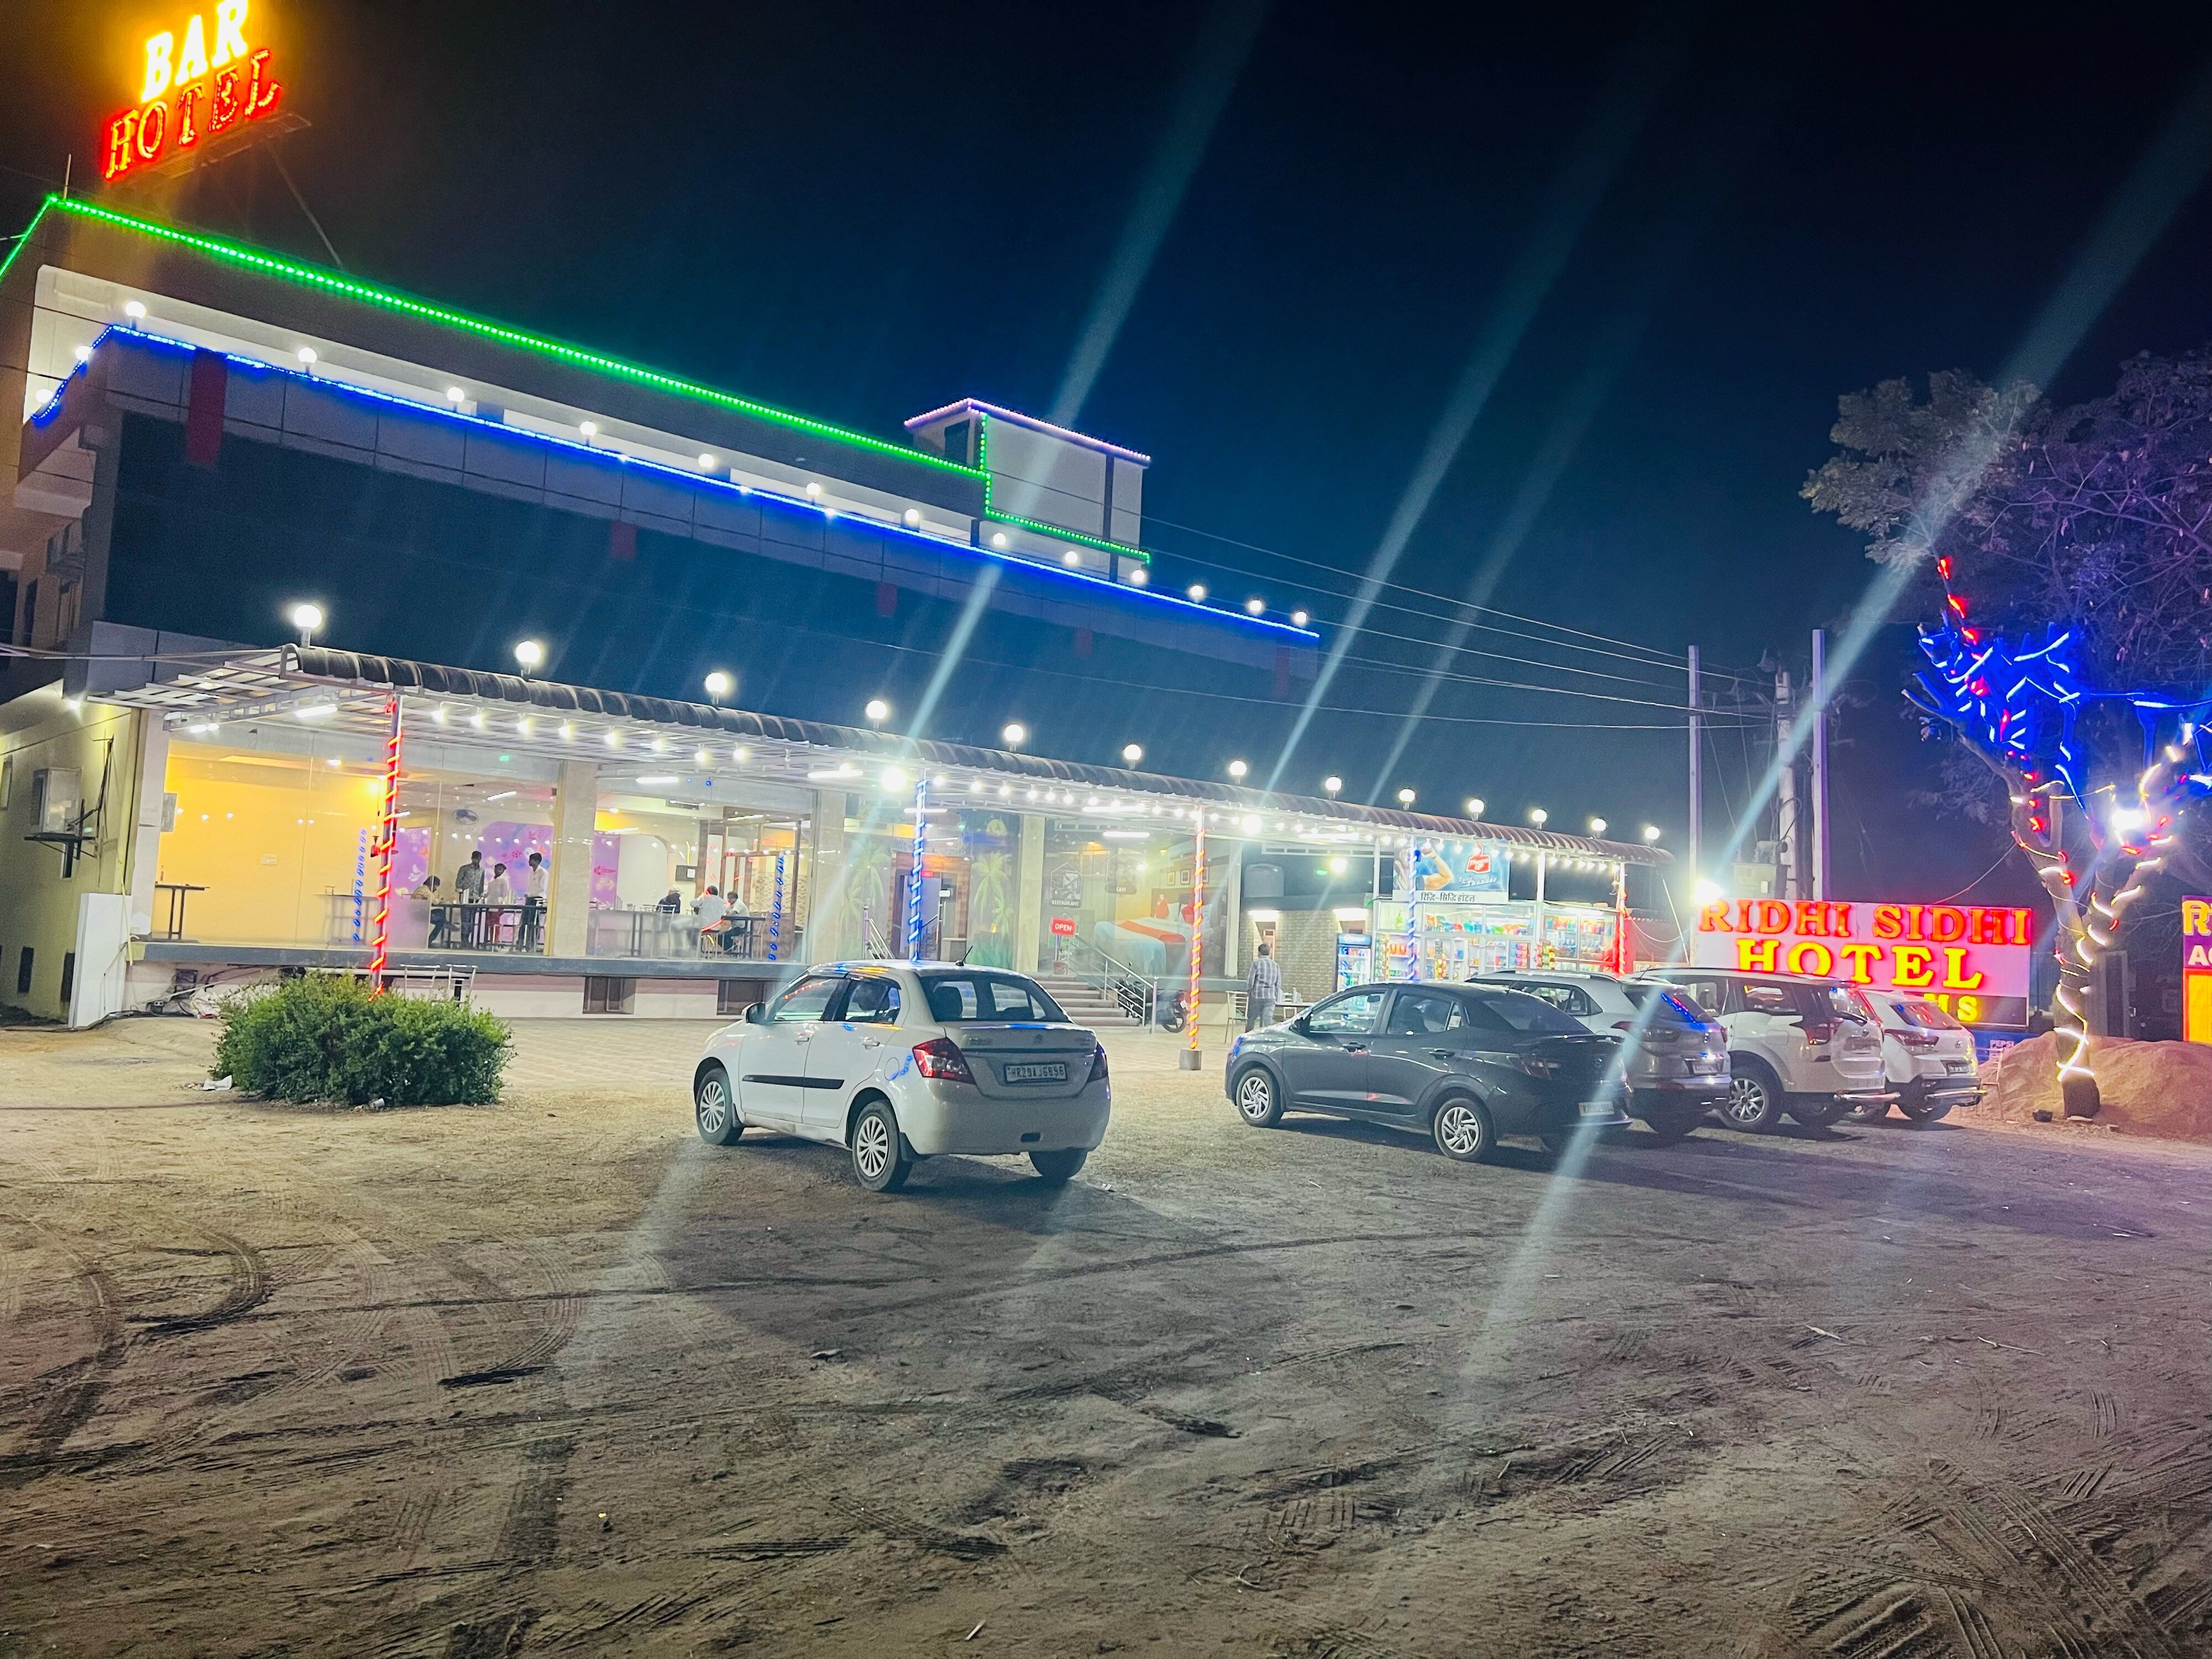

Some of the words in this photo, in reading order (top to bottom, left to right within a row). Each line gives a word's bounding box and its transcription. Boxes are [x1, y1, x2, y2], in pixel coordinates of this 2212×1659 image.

[141, 0, 248, 102] BAR
[104, 49, 282, 181] HOTEL
[1055, 923, 1072, 932] OPEN
[1699, 899, 1851, 937] RIDHI
[1872, 904, 2032, 945] SIDHI
[2182, 900, 2212, 936] R
[1735, 938, 1983, 989] HOTEL
[2188, 945, 2212, 966] A
[1990, 1040, 2015, 1048] PEPSI
